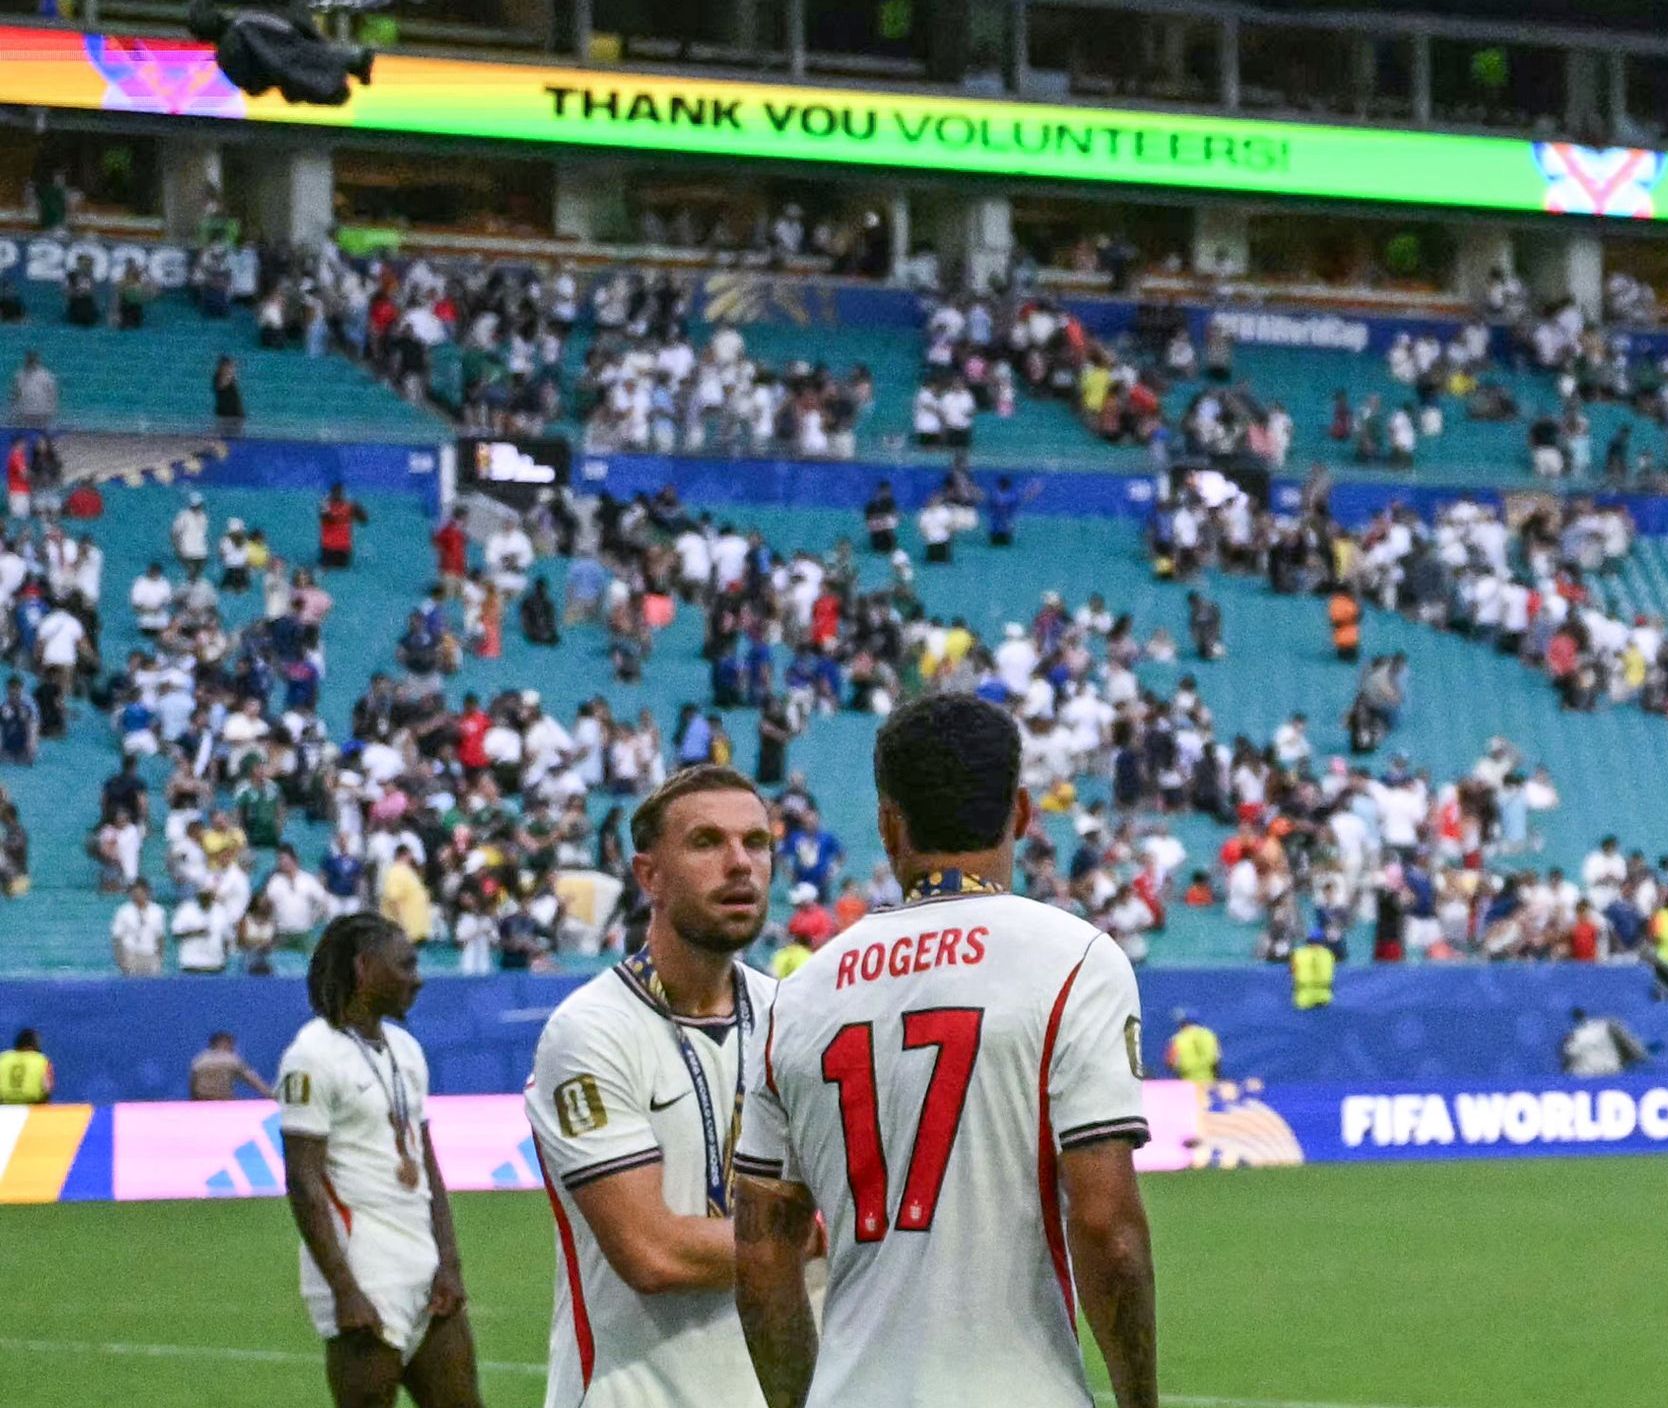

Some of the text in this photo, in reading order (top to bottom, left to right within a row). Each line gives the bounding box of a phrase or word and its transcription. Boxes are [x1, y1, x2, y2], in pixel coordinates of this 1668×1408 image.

[545, 86, 1290, 172] THANK YOU VOLUNTEERS!
[835, 925, 990, 990] ROGERS
[820, 1005, 985, 1243] 17
[1341, 1093, 1455, 1147] FIFA
[1456, 1089, 1636, 1145] WORLD
